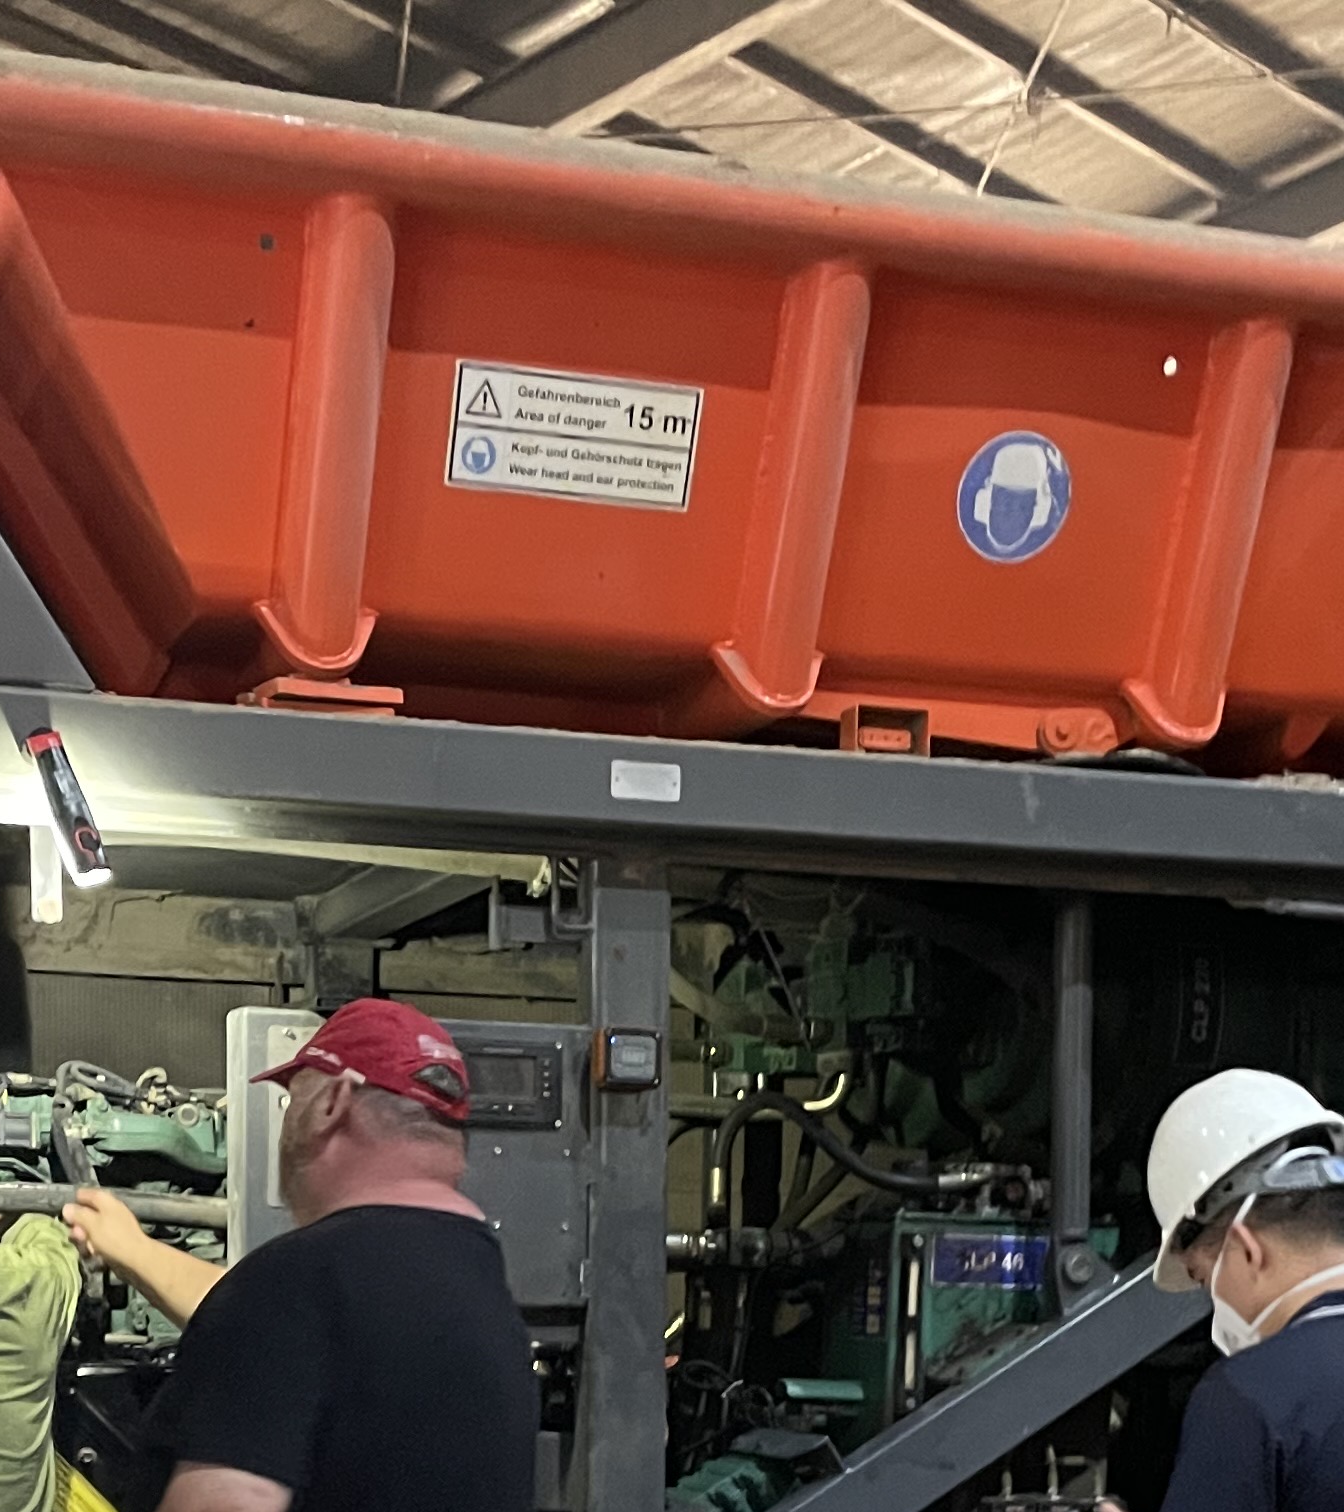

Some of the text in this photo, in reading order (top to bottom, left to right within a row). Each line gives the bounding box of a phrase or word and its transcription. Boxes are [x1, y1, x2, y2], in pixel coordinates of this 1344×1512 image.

[517, 384, 621, 409] Gefahrenbereich
[514, 407, 607, 430] Area of danger
[623, 403, 687, 435] 15 m
[545, 445, 567, 460] und
[646, 454, 682, 473] tragen
[508, 463, 675, 492] Wear head and ear protection
